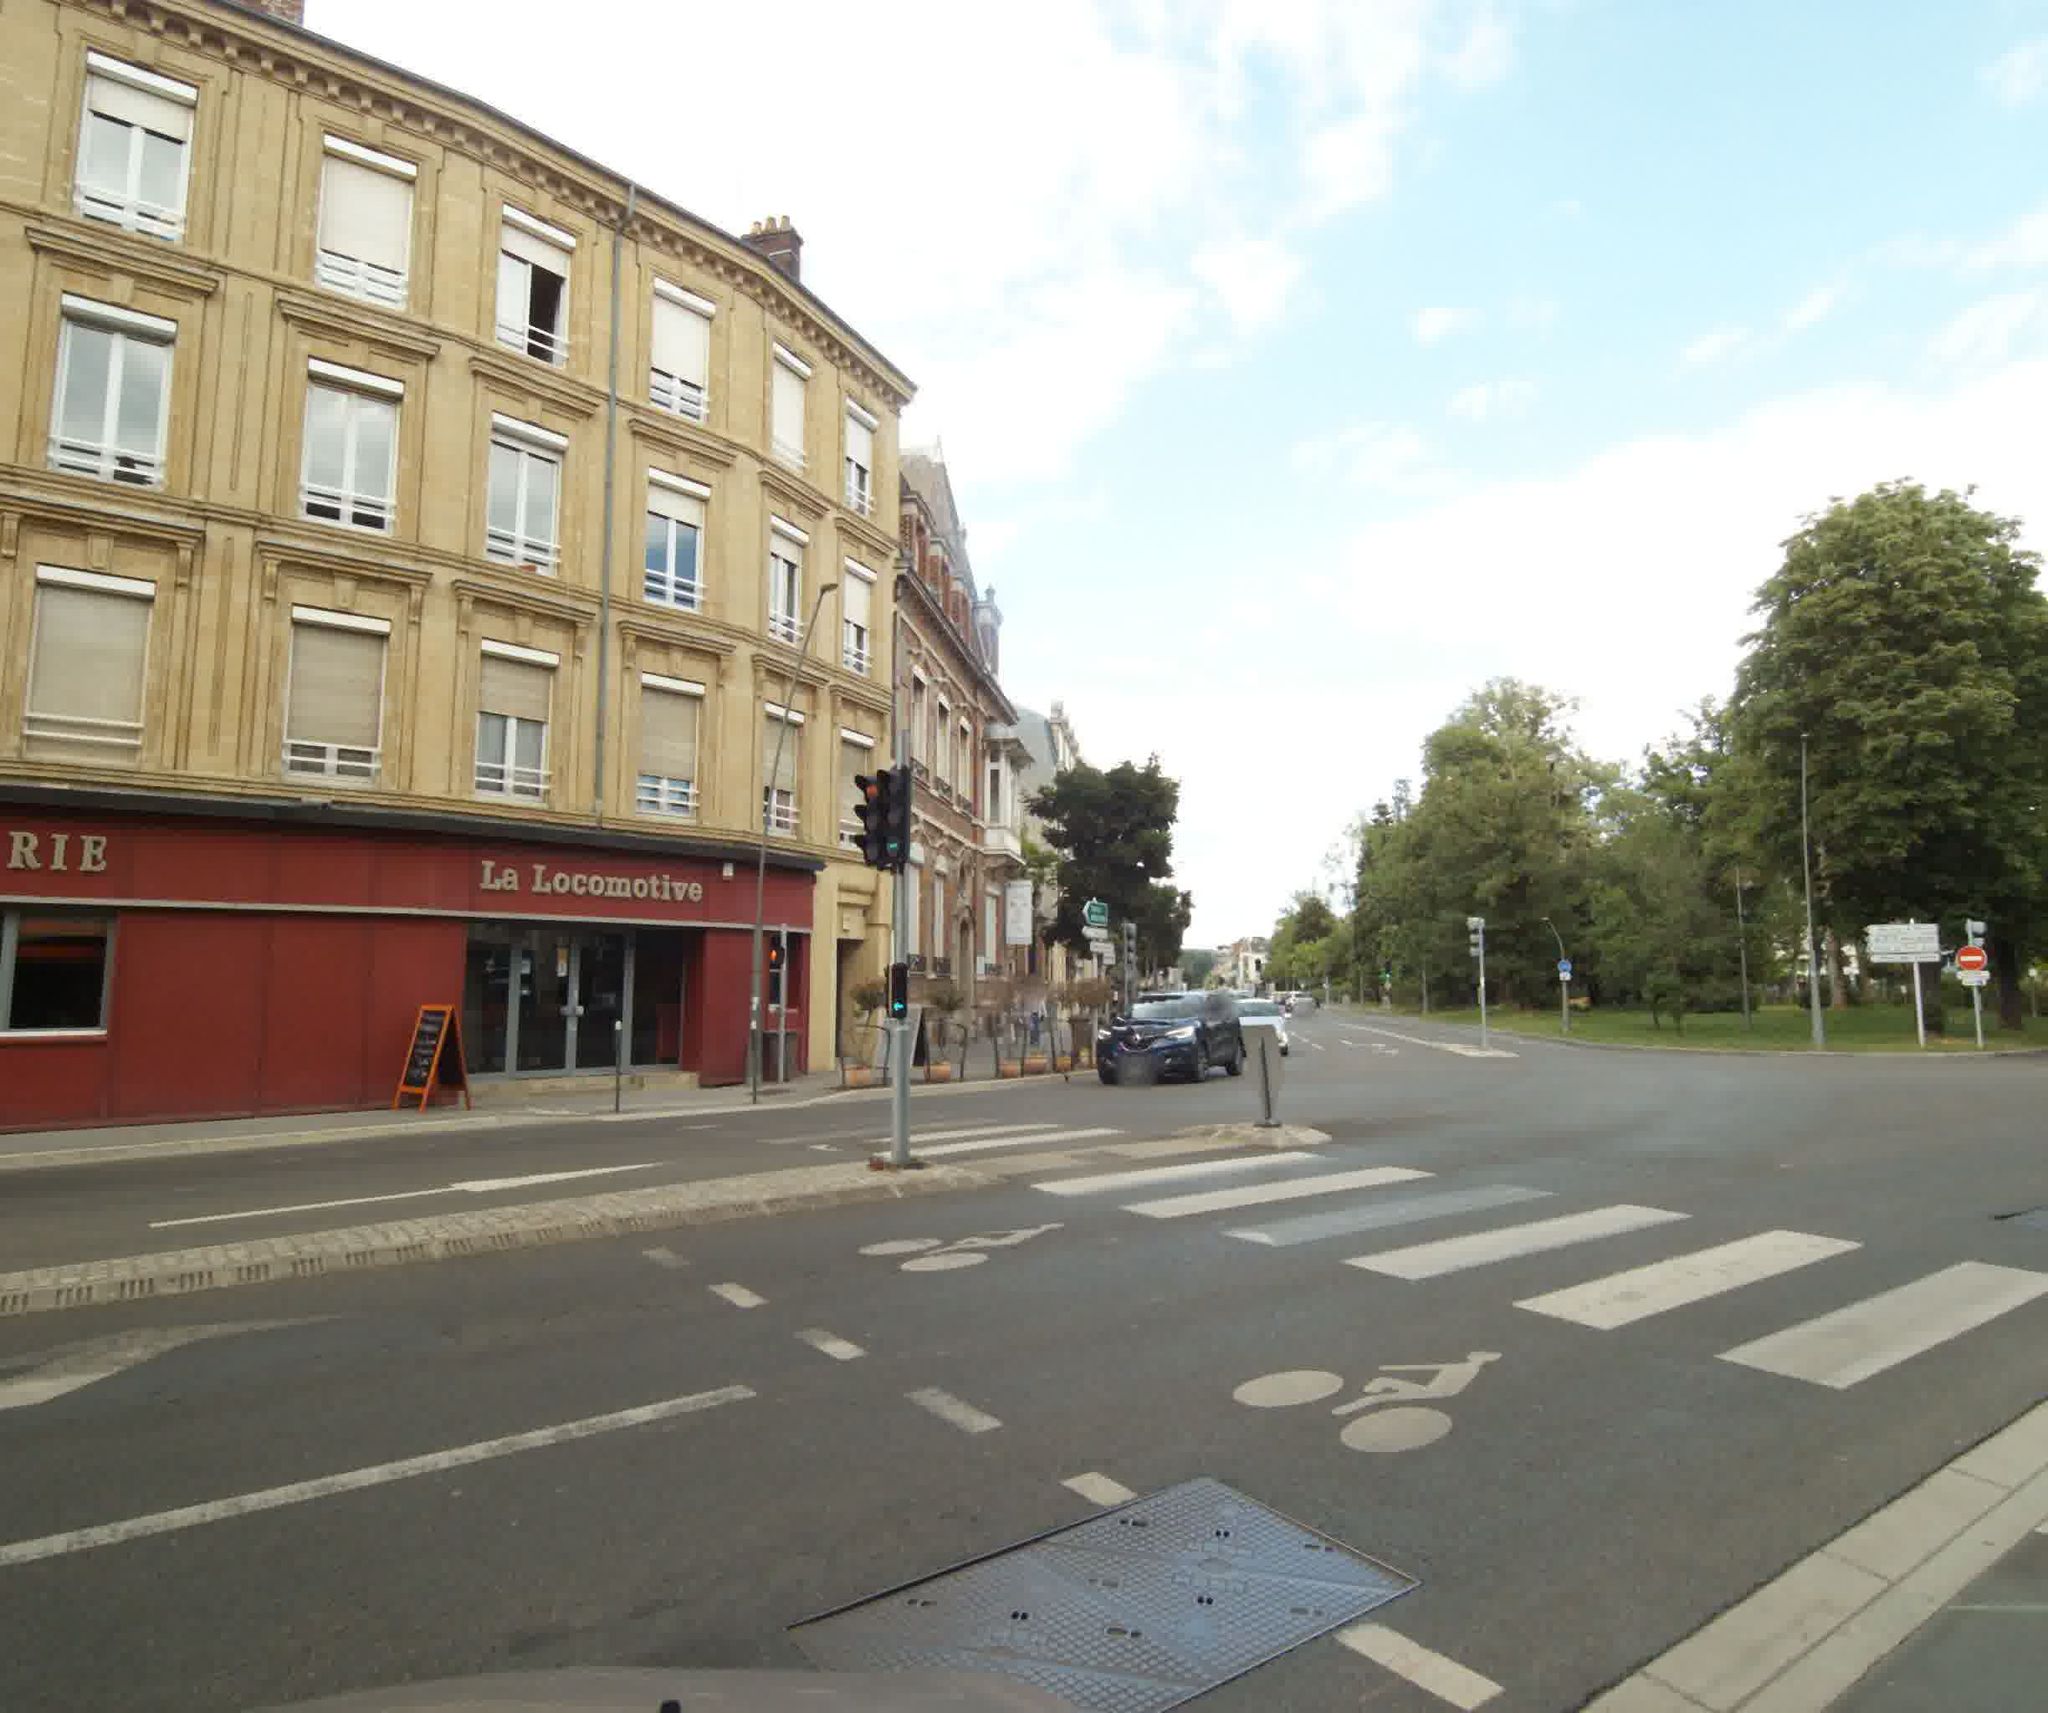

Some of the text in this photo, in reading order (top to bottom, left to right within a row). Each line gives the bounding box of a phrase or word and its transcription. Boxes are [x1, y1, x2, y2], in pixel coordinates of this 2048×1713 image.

[6, 831, 107, 872] RIE
[479, 860, 704, 902] La Locomotive
